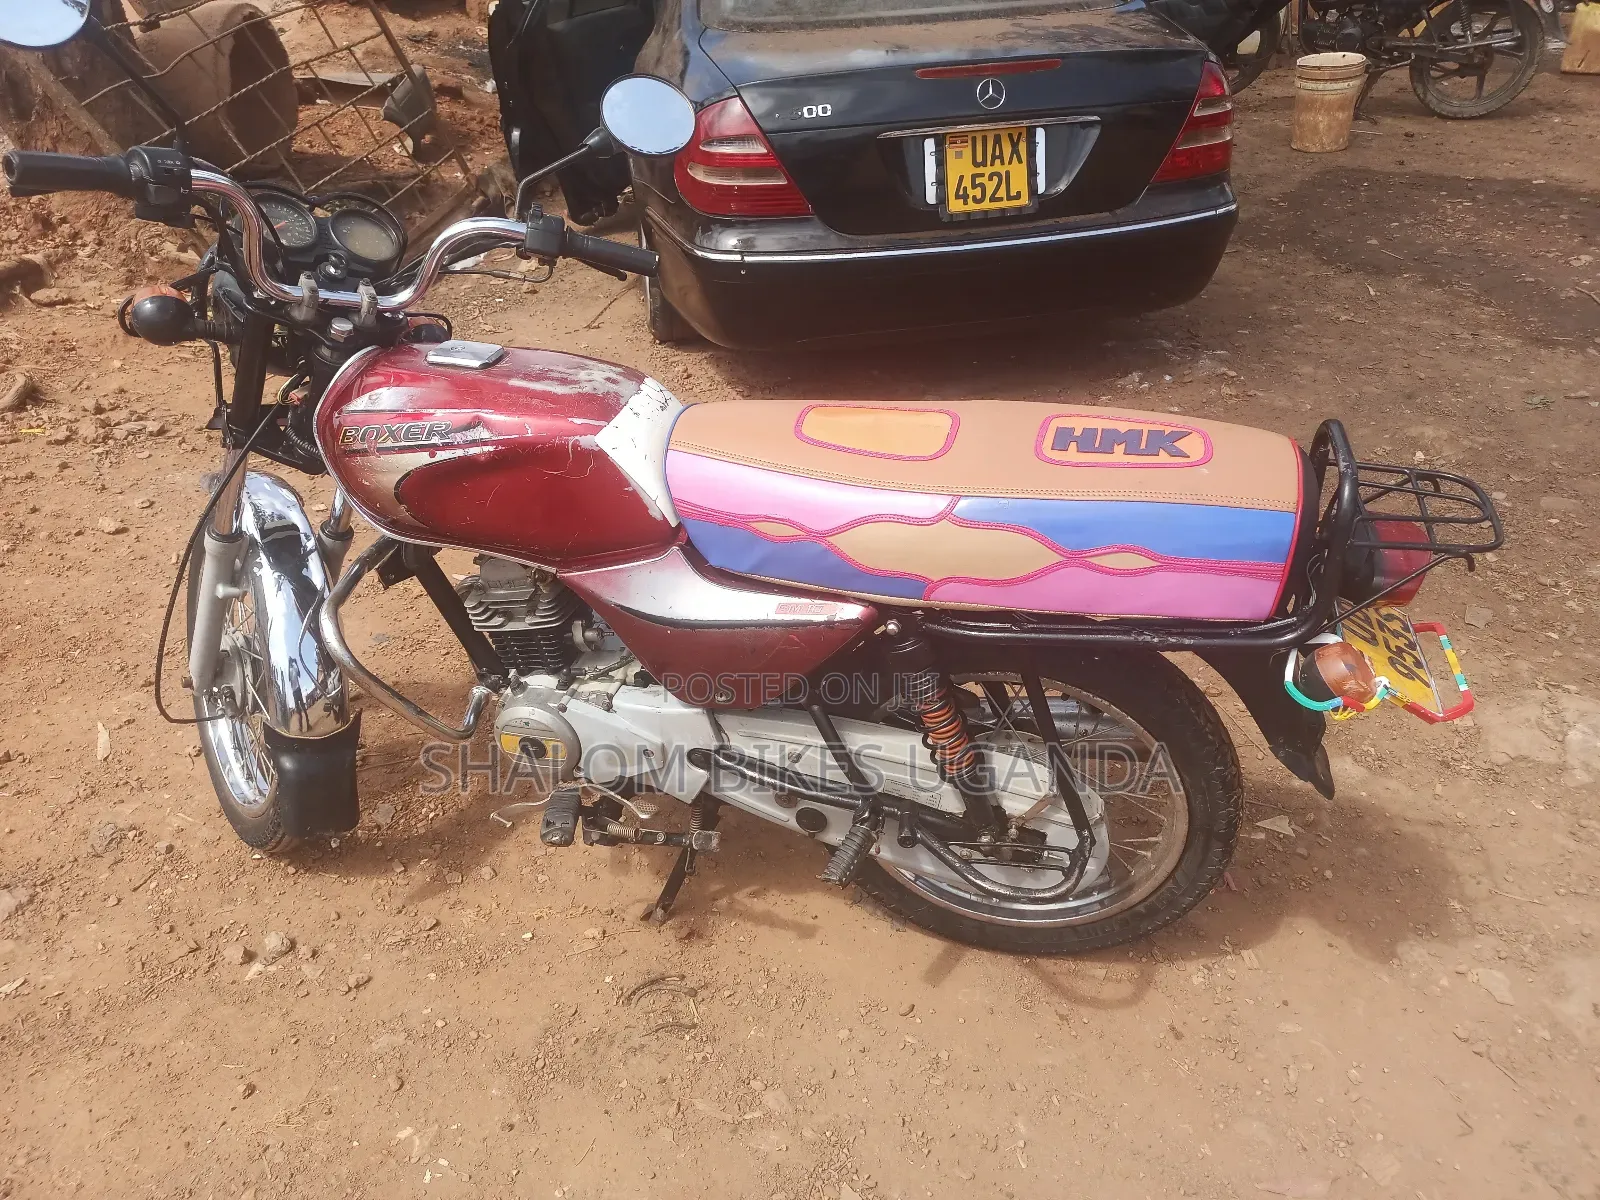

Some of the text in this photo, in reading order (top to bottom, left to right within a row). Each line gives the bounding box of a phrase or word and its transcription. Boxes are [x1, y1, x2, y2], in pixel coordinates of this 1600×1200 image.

[971, 132, 1023, 168] UAX
[954, 170, 1021, 206] 452L
[339, 421, 452, 445] BOXER
[1051, 426, 1193, 458] HMK
